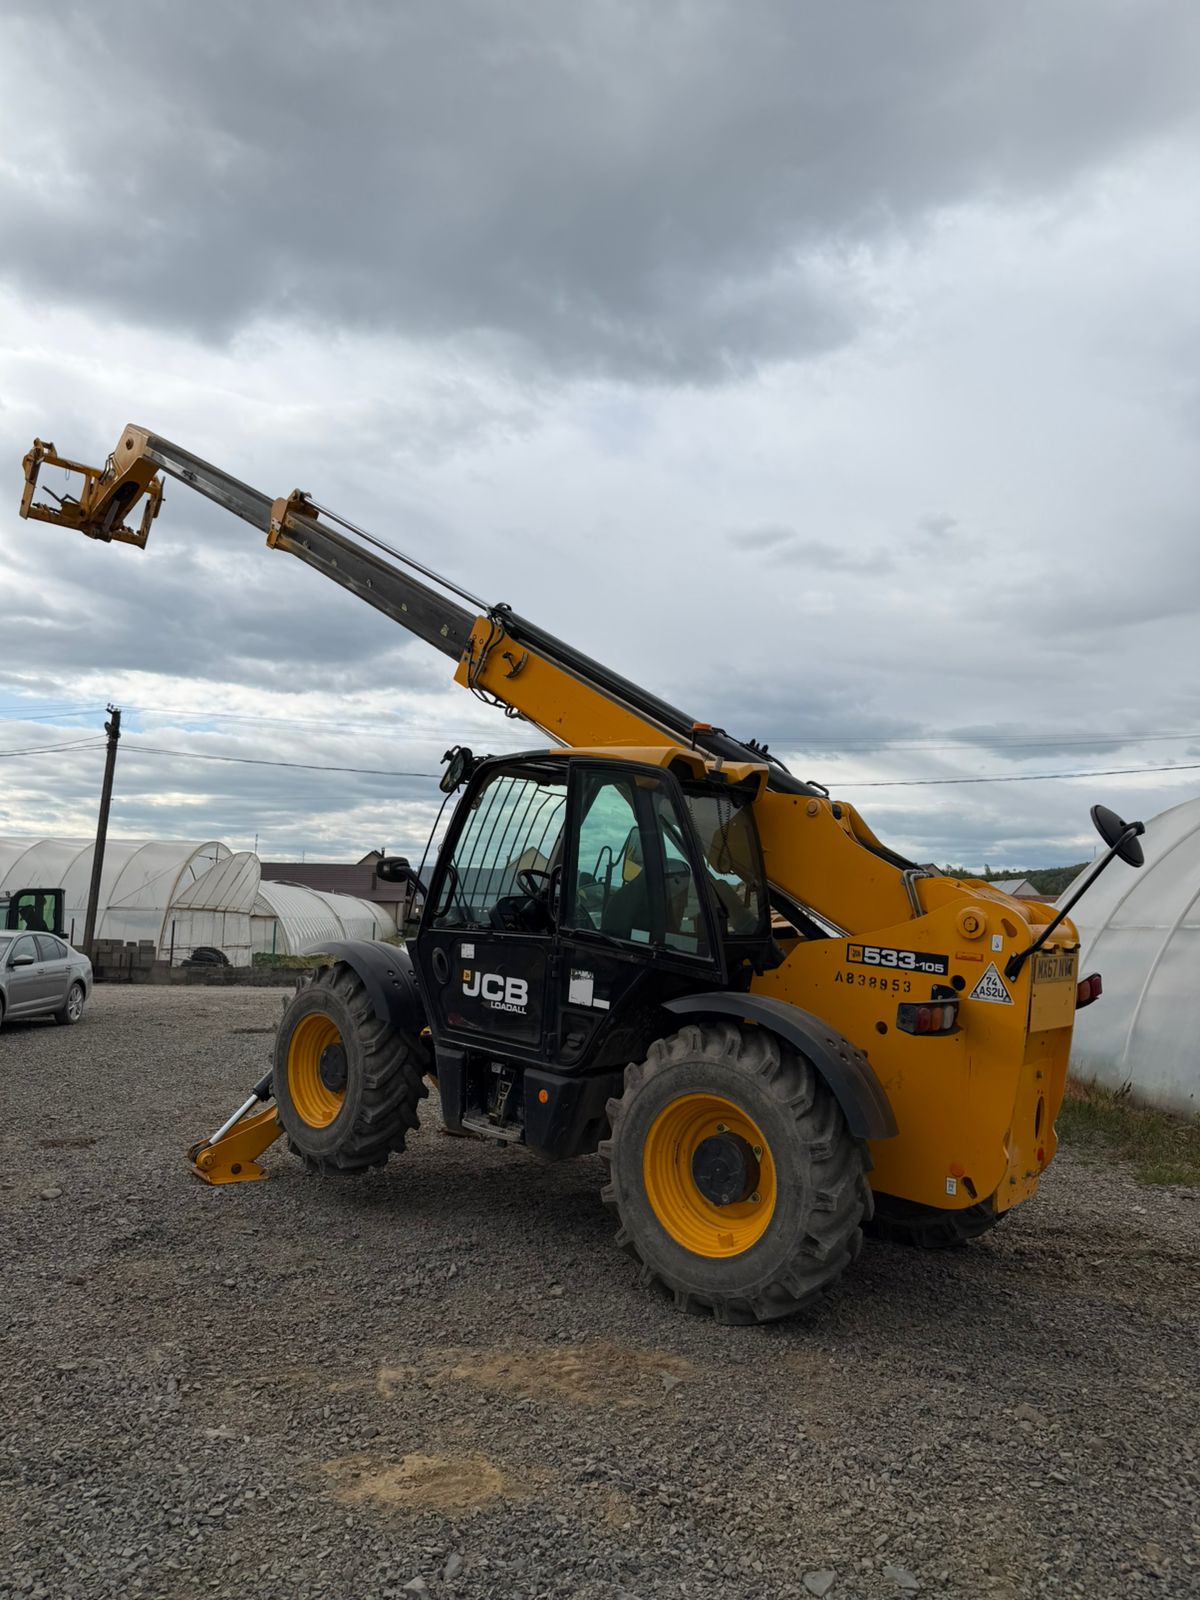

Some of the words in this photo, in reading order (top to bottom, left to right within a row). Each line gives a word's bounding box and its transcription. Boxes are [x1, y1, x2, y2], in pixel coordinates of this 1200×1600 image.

[835, 971, 911, 992] A838953
[986, 976, 998, 986] 74
[463, 971, 528, 1006] JCB
[979, 986, 1004, 998] AS2U
[490, 1001, 527, 1015] LOADALL
